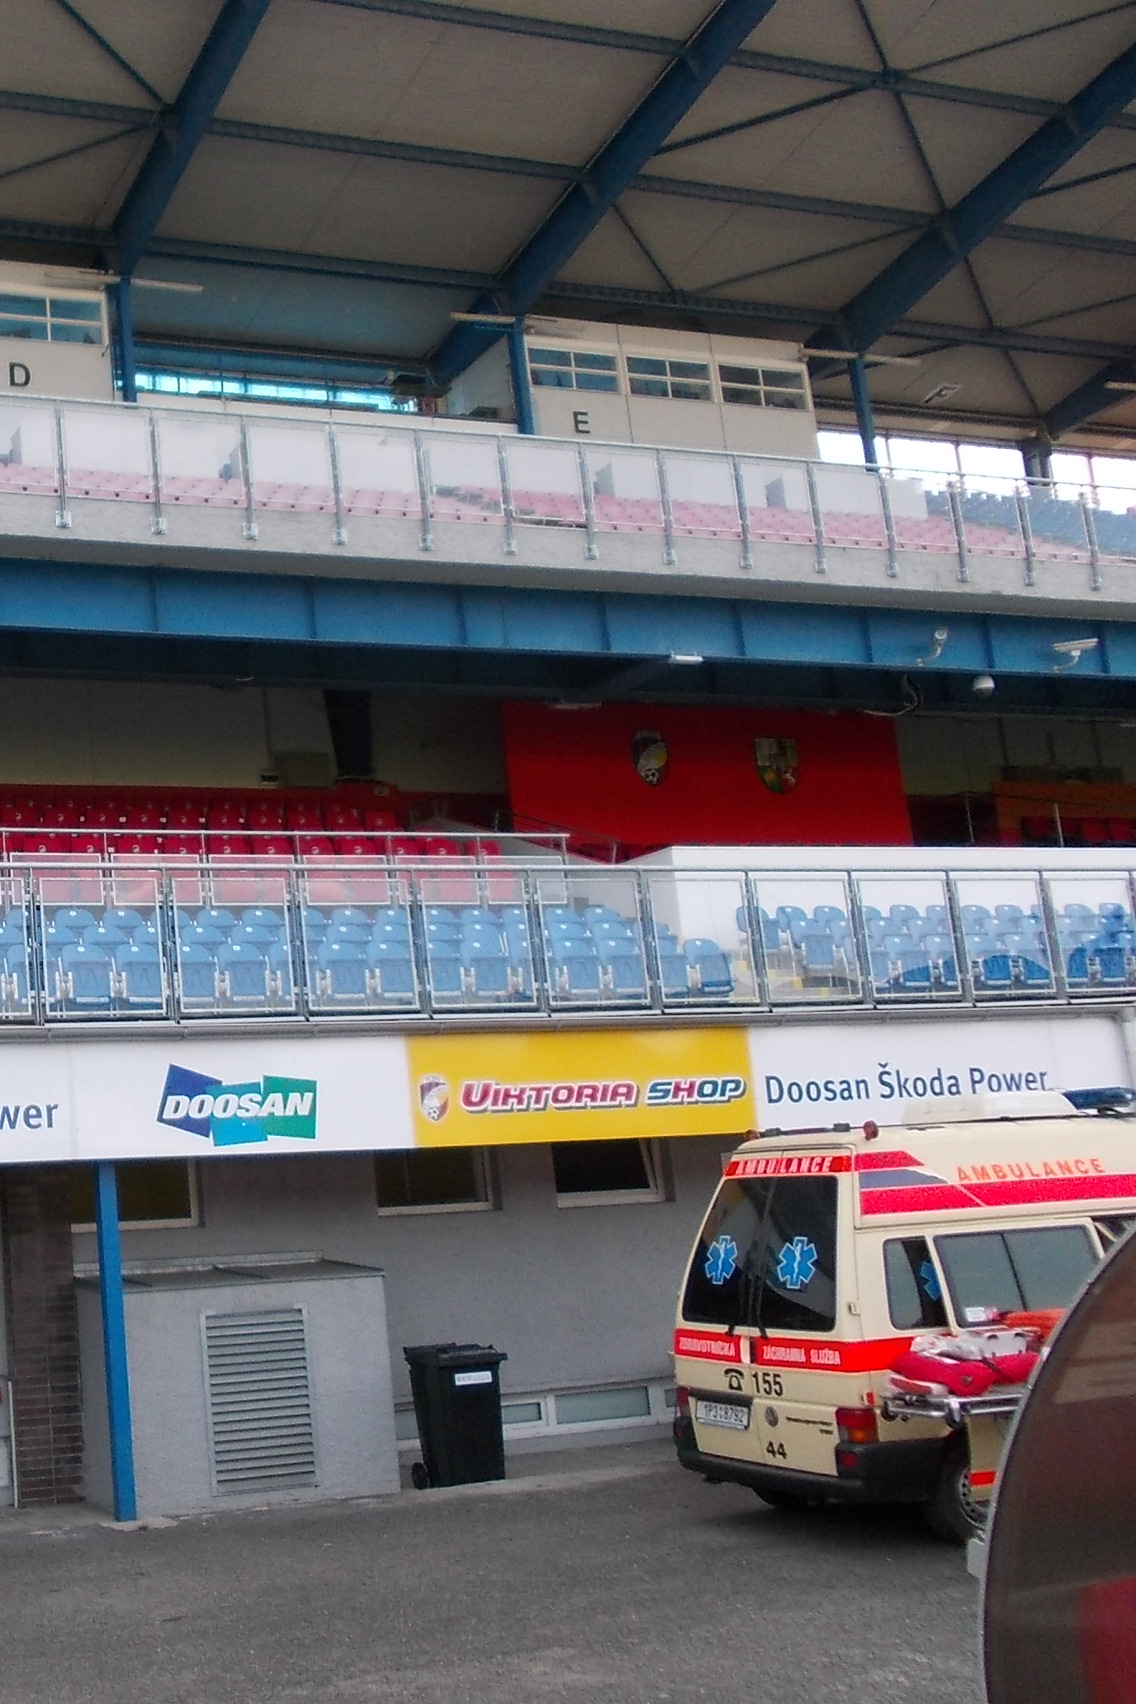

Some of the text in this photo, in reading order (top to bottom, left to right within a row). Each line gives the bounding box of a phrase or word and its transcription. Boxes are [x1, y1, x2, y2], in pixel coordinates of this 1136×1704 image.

[9, 361, 31, 387] D
[573, 411, 591, 434] E
[646, 1077, 746, 1106] SHOP
[765, 1062, 1048, 1104] Doosan Škoda Power
[162, 1091, 314, 1119] DOOSAN
[735, 1156, 833, 1175] AMBULANCE
[955, 1159, 1105, 1182] AMBULANCE
[752, 1371, 784, 1397] 155
[766, 1441, 788, 1459] 44
